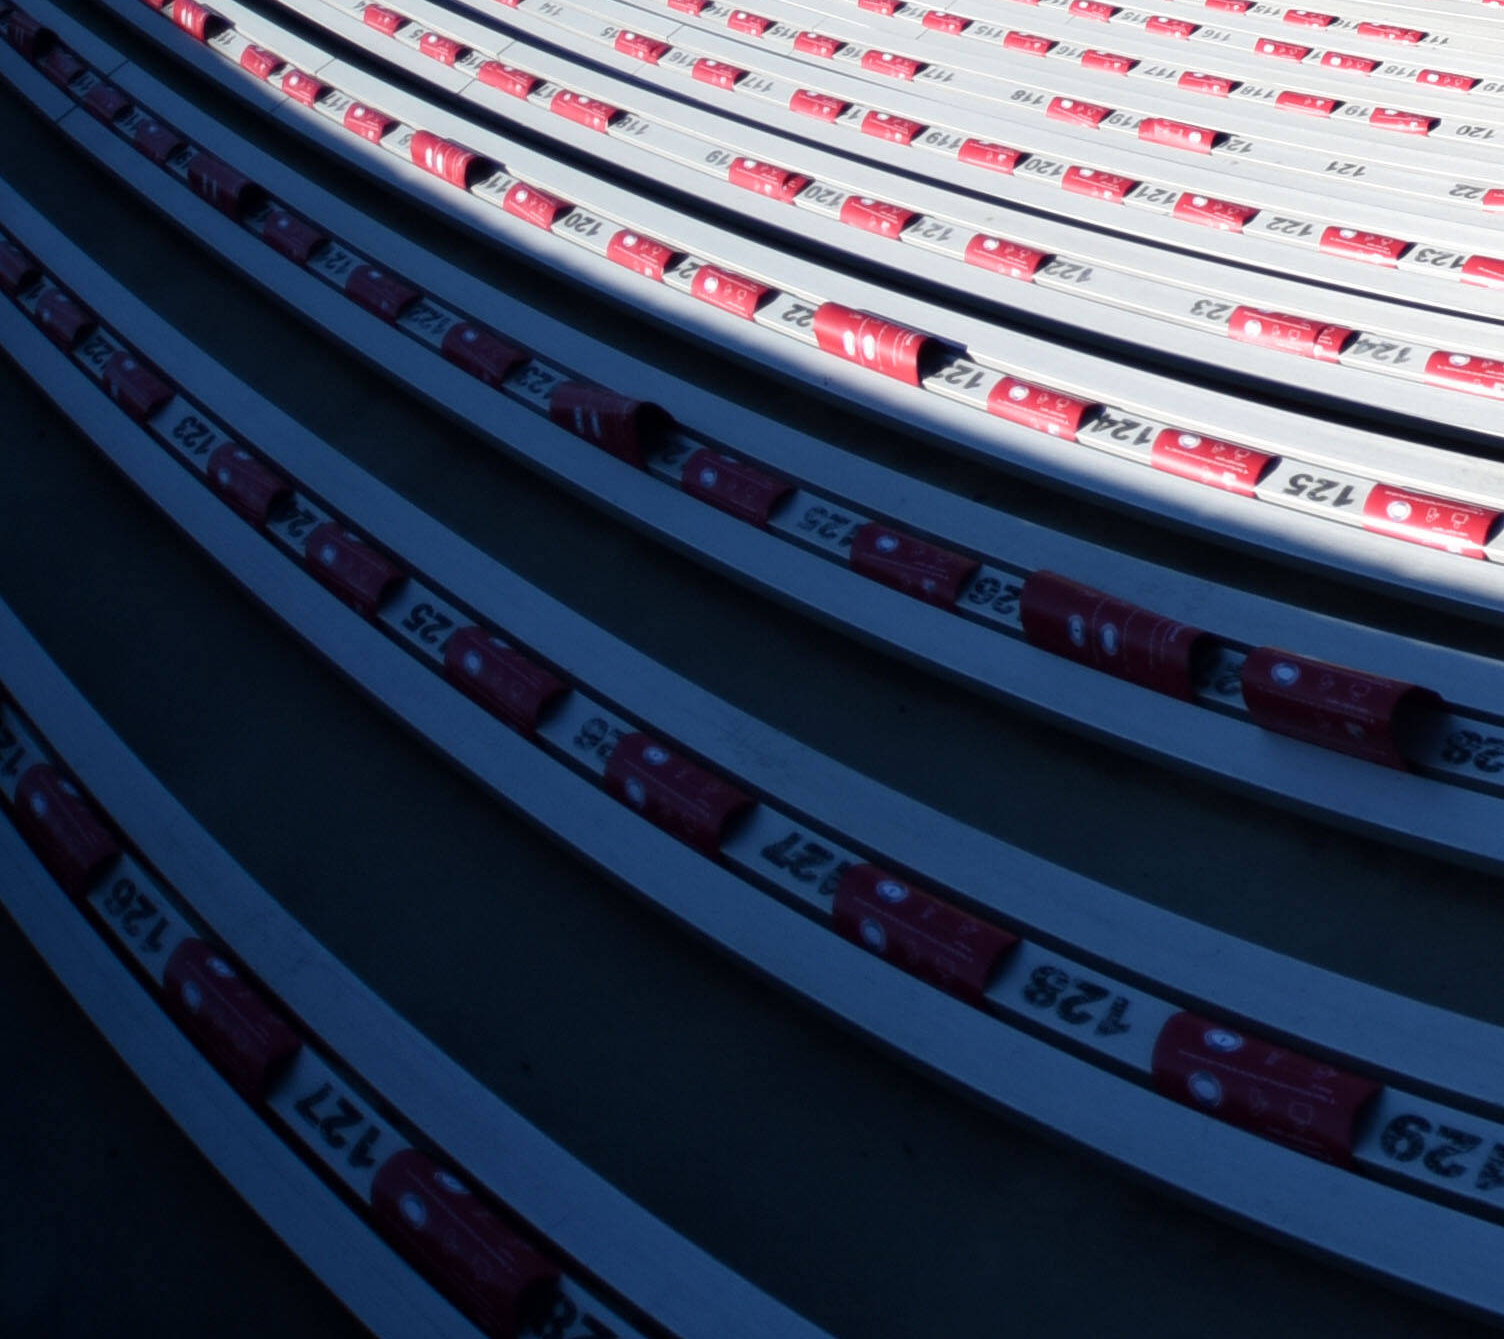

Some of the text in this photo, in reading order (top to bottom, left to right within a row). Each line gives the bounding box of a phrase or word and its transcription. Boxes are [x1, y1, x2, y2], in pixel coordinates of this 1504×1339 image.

[925, 132, 962, 150] 119
[1455, 124, 1496, 140] 120
[1325, 161, 1367, 178] 121
[1266, 216, 1315, 237] 122
[1045, 261, 1096, 283] 122
[1283, 472, 1357, 508] 125
[1019, 965, 1132, 1038] 128
[294, 1078, 380, 1171] 127
